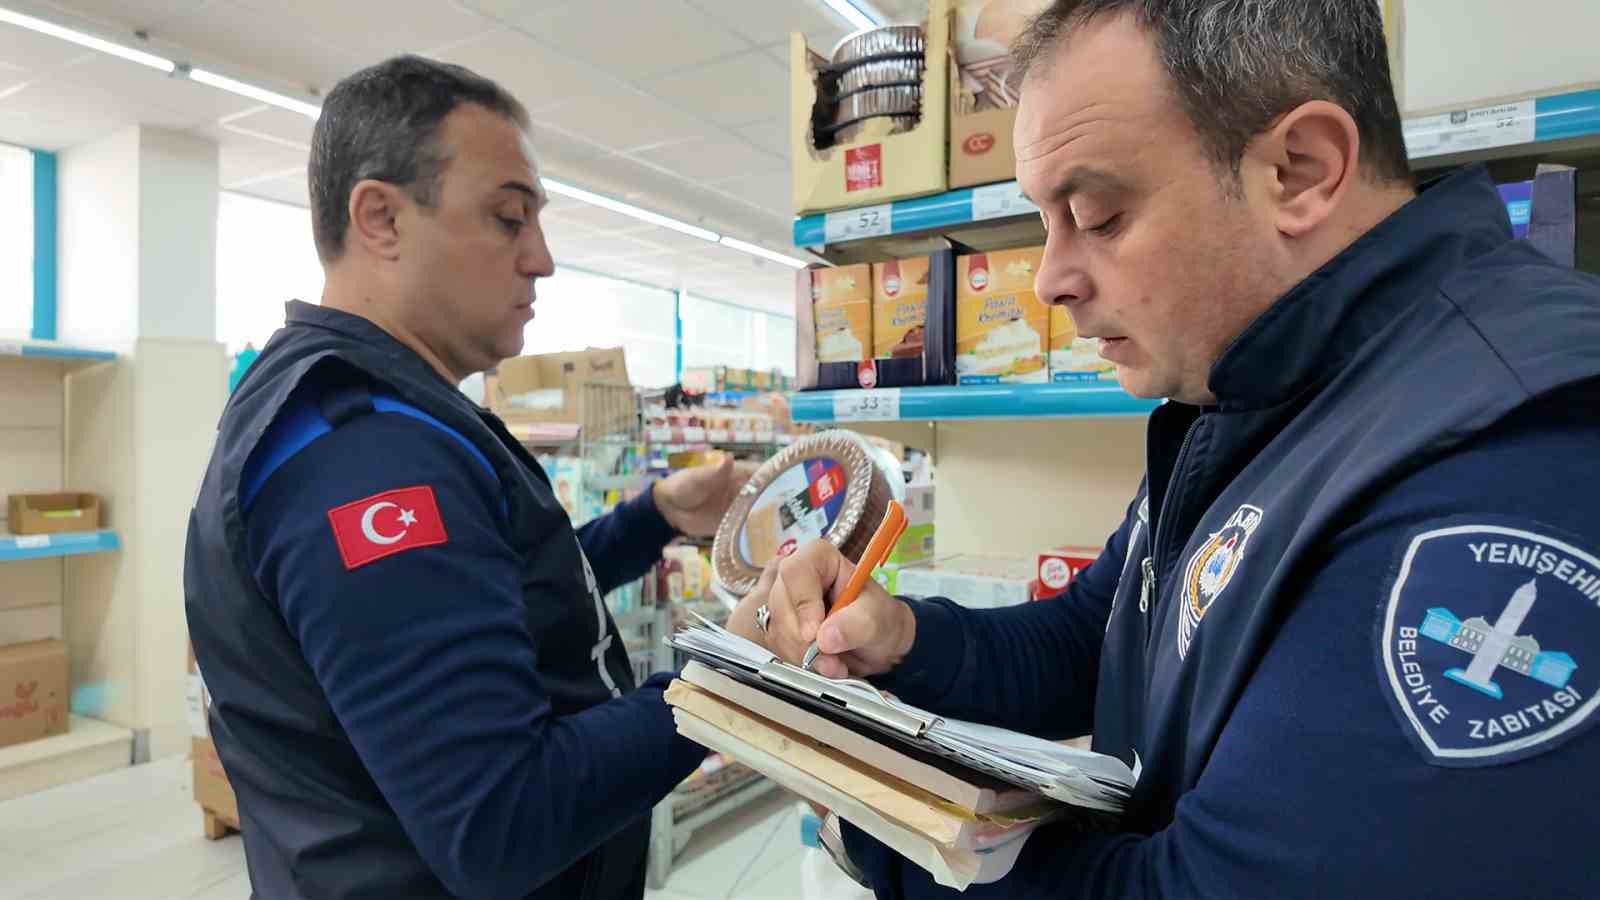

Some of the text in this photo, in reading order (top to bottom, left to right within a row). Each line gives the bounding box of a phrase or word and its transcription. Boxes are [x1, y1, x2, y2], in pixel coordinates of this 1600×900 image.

[859, 211, 880, 228] 52
[859, 396, 879, 410] 33
[1398, 626, 1450, 725] BELEDİYE
[1468, 685, 1583, 739] ZABITASI
